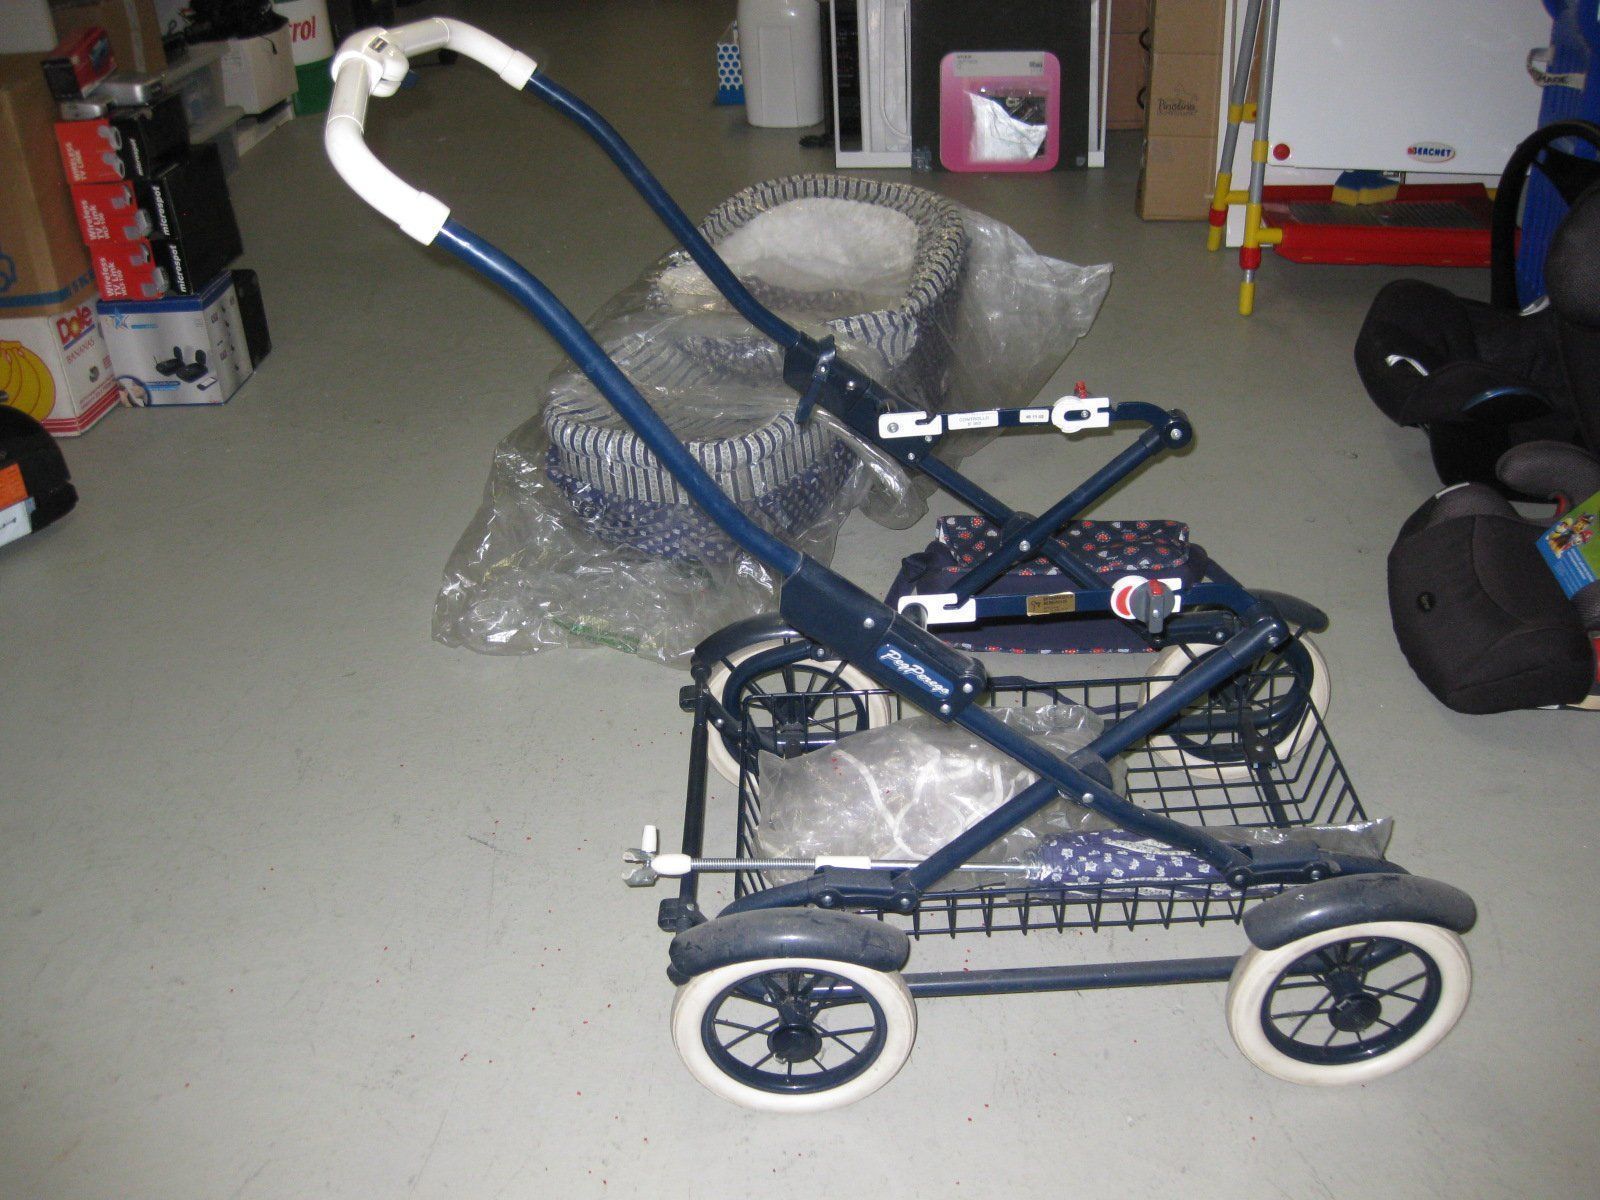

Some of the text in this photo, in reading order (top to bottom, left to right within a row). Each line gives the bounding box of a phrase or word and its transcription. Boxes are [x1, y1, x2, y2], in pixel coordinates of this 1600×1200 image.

[289, 15, 316, 42] rol
[81, 199, 98, 240] Wireless
[89, 204, 104, 240] TV Link
[152, 186, 170, 236] microspot
[100, 256, 114, 297] Wireless
[109, 262, 122, 296] TV Link
[169, 244, 186, 293] microspot
[56, 305, 93, 345] Dole
